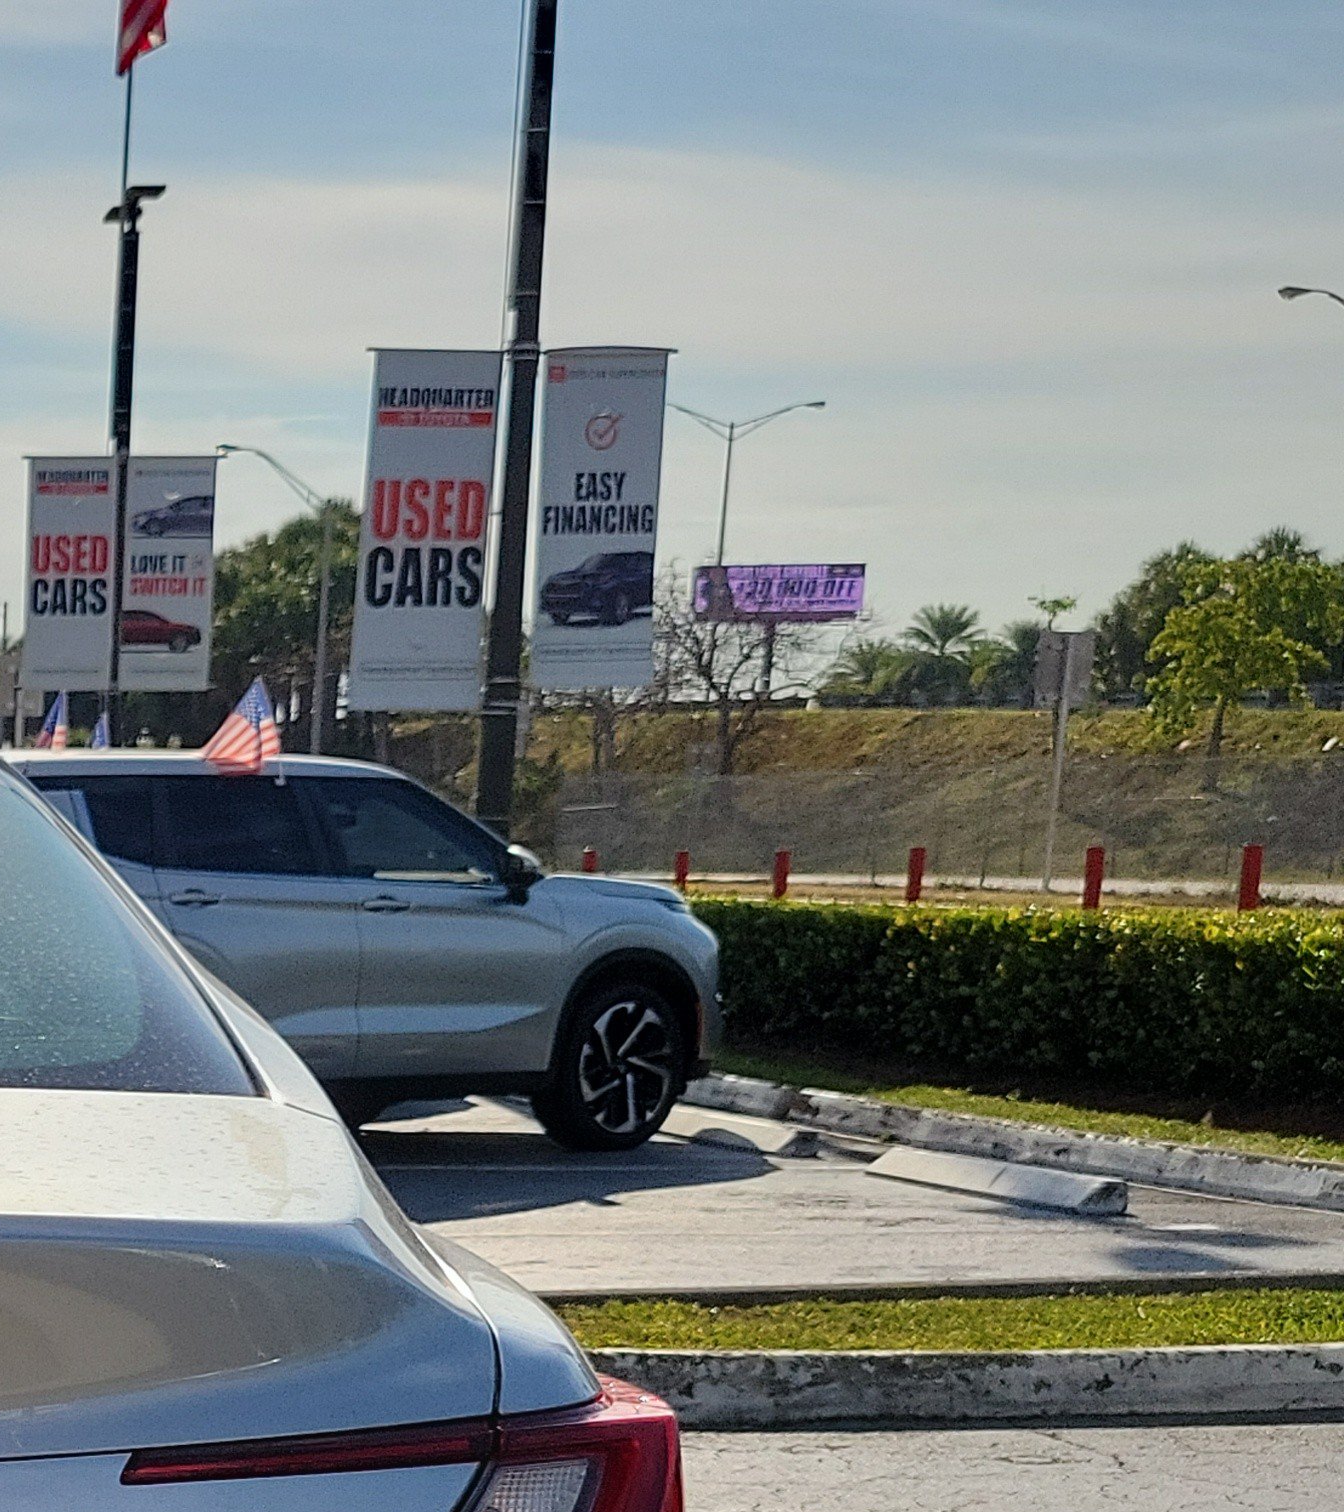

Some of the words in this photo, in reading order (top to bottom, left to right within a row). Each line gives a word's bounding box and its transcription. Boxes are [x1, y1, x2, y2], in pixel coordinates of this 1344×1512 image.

[379, 387, 494, 409] HEADQUARTER
[574, 471, 627, 501] EASY
[371, 478, 486, 541] USED
[542, 504, 654, 536] FINANCING
[32, 534, 108, 574] USED
[130, 554, 167, 574] LOVE
[172, 554, 186, 573] IT
[365, 546, 483, 608] CARS
[32, 578, 108, 615] CARS
